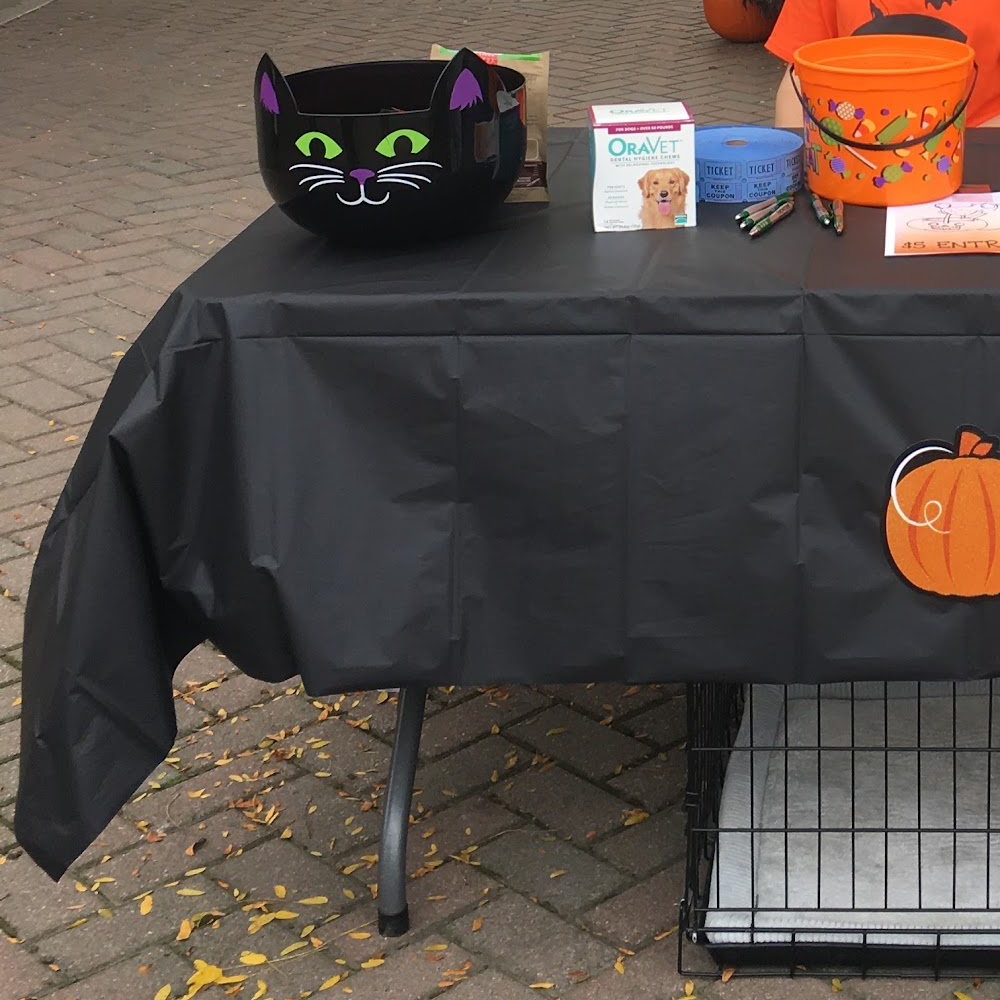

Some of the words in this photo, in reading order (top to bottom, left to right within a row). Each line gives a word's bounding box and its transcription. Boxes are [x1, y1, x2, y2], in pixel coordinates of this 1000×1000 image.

[706, 165, 733, 176] TICKET
[749, 163, 775, 174] TICKET
[748, 189, 776, 198] COUPON
[901, 241, 926, 249] $5
